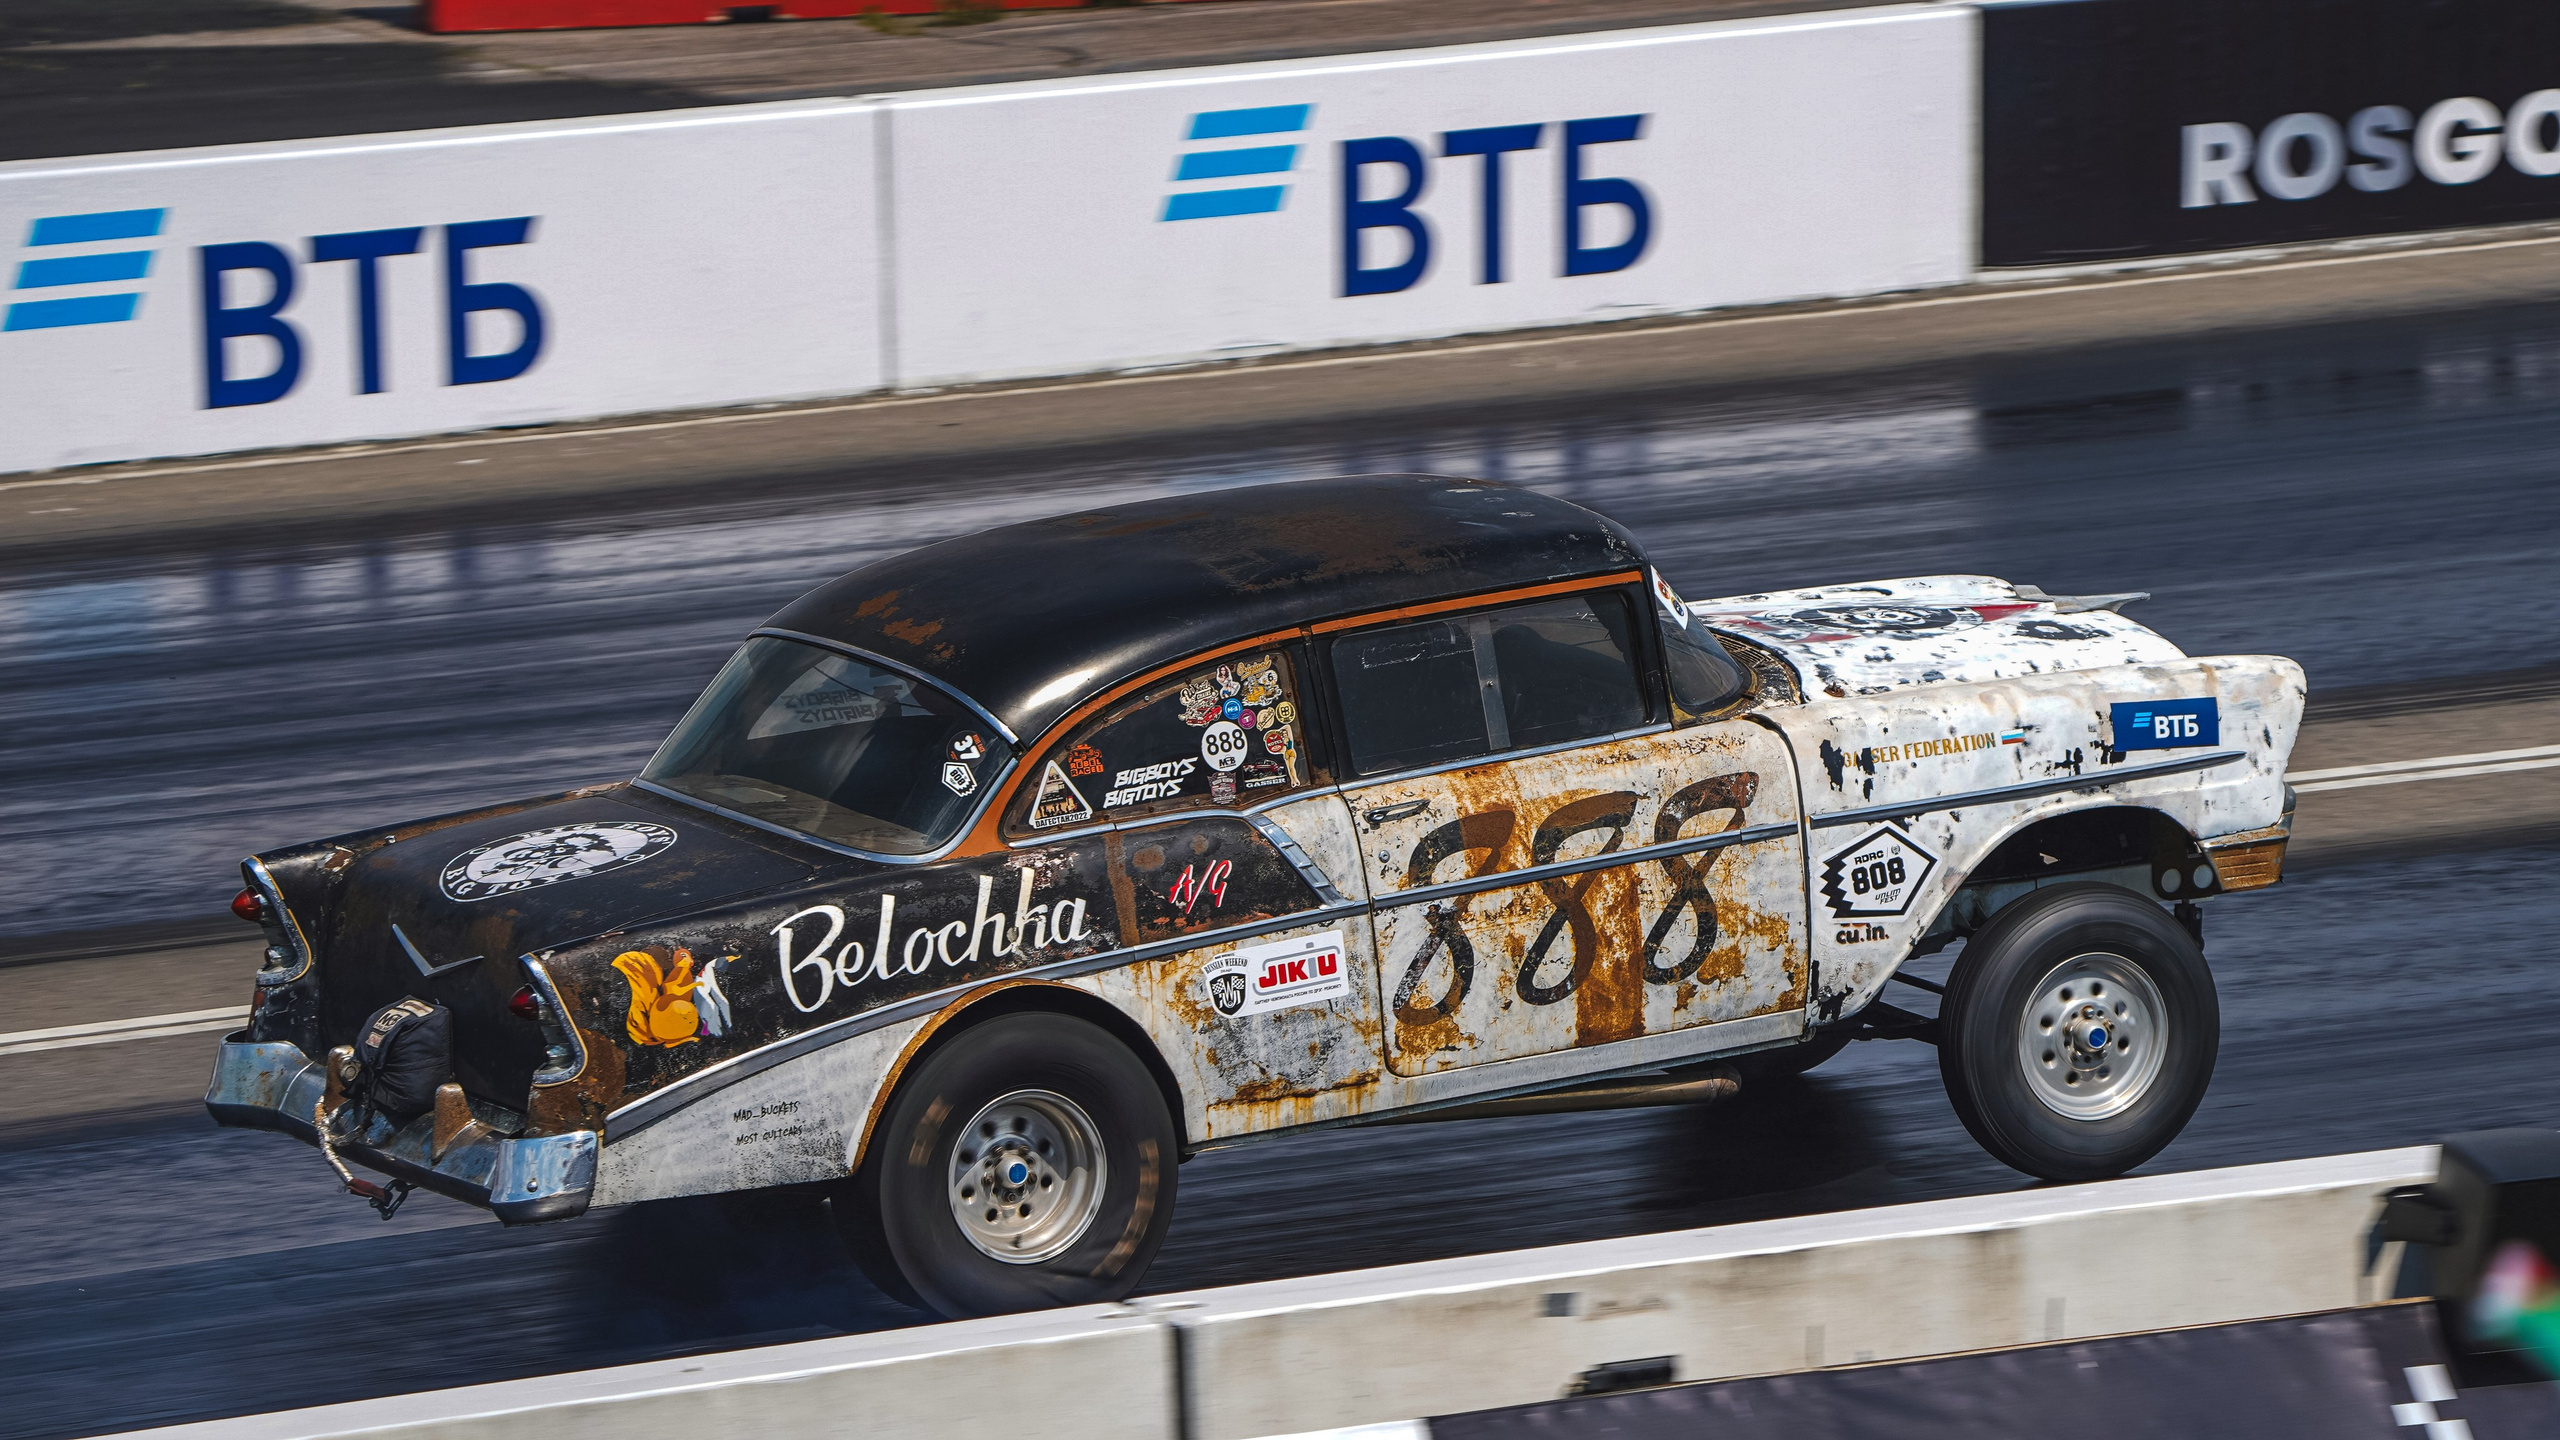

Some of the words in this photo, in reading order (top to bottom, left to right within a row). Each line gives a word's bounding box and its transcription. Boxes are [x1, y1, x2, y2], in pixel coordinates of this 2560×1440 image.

[1337, 113, 1656, 298] ВТБ
[197, 215, 546, 410] ВТБ
[2154, 713, 2200, 740] ВТБ
[954, 734, 981, 760] 37
[1205, 728, 1245, 756] 888
[1903, 732, 1996, 758] FEDERATION
[1069, 758, 1102, 770] REBEL
[1070, 764, 1104, 778] RACE!
[1114, 757, 1199, 788] BIGBOYS
[1103, 778, 1184, 809] BIGTOYS
[1246, 777, 1286, 789] GASSER
[1854, 850, 1884, 865] RDRC
[446, 865, 477, 896] BIG
[485, 868, 593, 896] TOYS
[1169, 859, 1233, 914] A/G
[1851, 857, 1907, 896] 808
[1392, 772, 1759, 1026] 888
[770, 867, 1091, 1013] Belochka
[1259, 953, 1338, 989] JIKIU
[733, 1101, 801, 1122] MAD_BUCKETS
[735, 1132, 758, 1146] MOST
